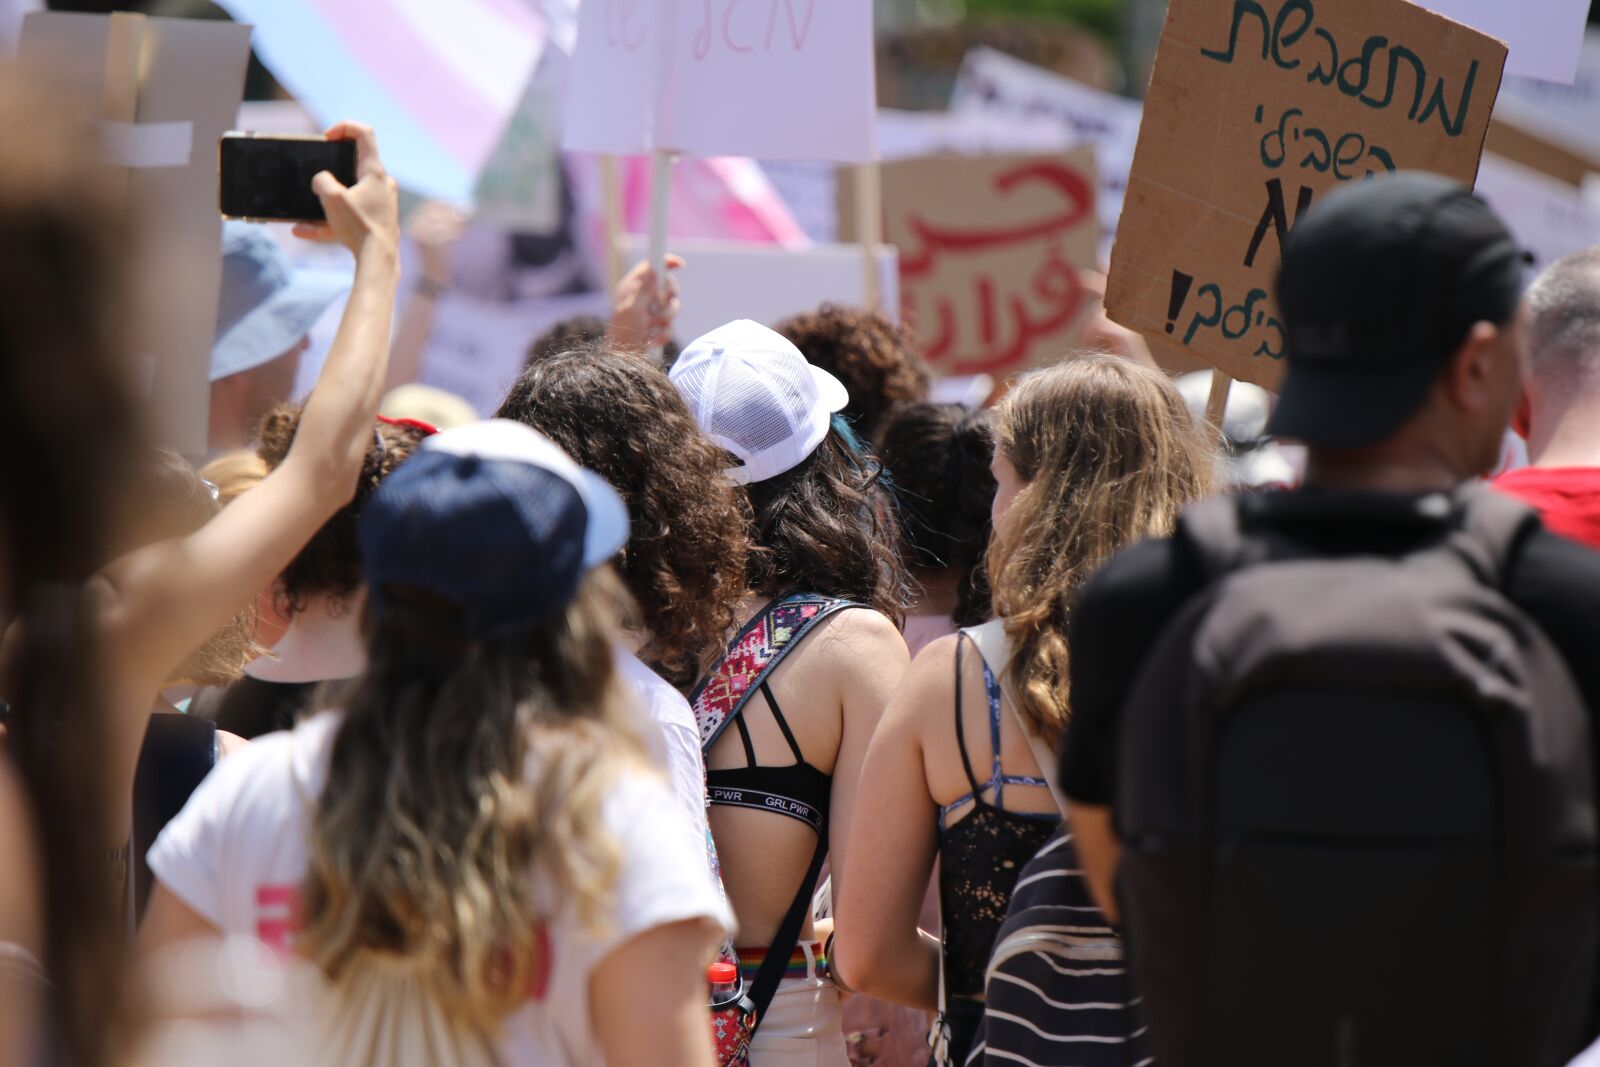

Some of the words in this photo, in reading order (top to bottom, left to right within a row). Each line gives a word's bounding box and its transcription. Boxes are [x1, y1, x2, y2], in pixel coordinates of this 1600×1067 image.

[1201, 0, 1480, 136] מתלבשת
[714, 790, 743, 801] PWR
[765, 796, 788, 810] GRL
[789, 802, 809, 817] PWR
